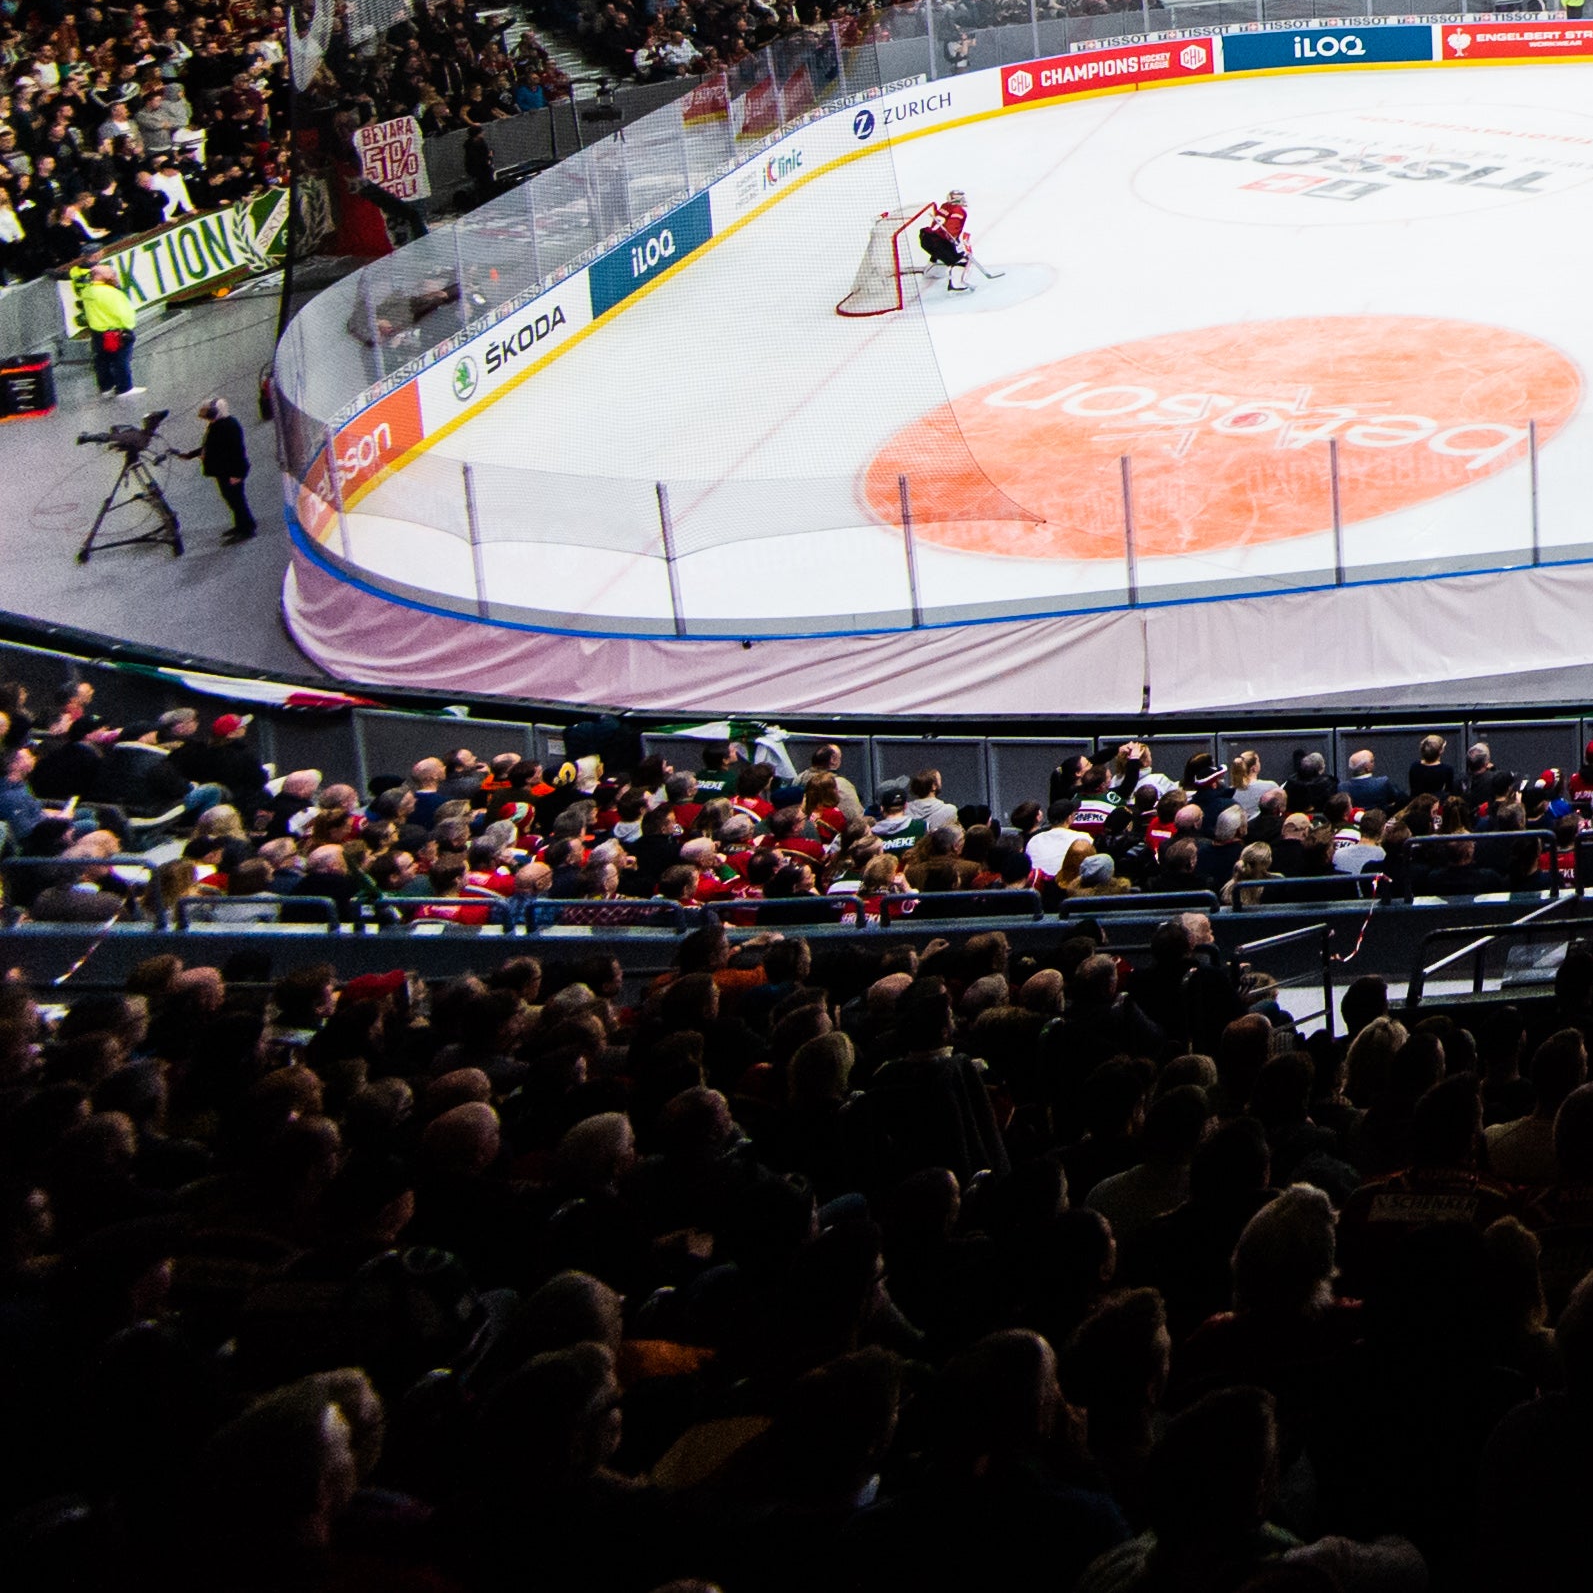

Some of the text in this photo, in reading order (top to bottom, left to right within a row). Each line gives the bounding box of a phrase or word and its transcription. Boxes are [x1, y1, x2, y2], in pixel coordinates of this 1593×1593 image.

[1261, 20, 1311, 31] TISSOT
[1339, 16, 1390, 27] TISSOT
[1418, 14, 1467, 24] TISSOT
[1495, 12, 1540, 22] TISSOT
[1100, 34, 1150, 48] TISSOT
[1181, 25, 1232, 38] TISSOT
[1476, 31, 1561, 43] ENGELBERT
[1293, 35, 1366, 58] iLOQ
[1139, 52, 1171, 64] HOCKEY
[1140, 61, 1170, 72] LEAGUE
[1041, 57, 1138, 87] CHAMPIONS
[878, 75, 921, 96] TISSOT
[883, 92, 951, 124] ZURICH
[362, 117, 414, 146] BEVARA
[364, 137, 419, 185] 51%
[1178, 139, 1553, 193] TISSOT
[108, 214, 238, 304] KTION
[631, 229, 677, 278] iLOQ
[484, 304, 568, 374] ŠKODA
